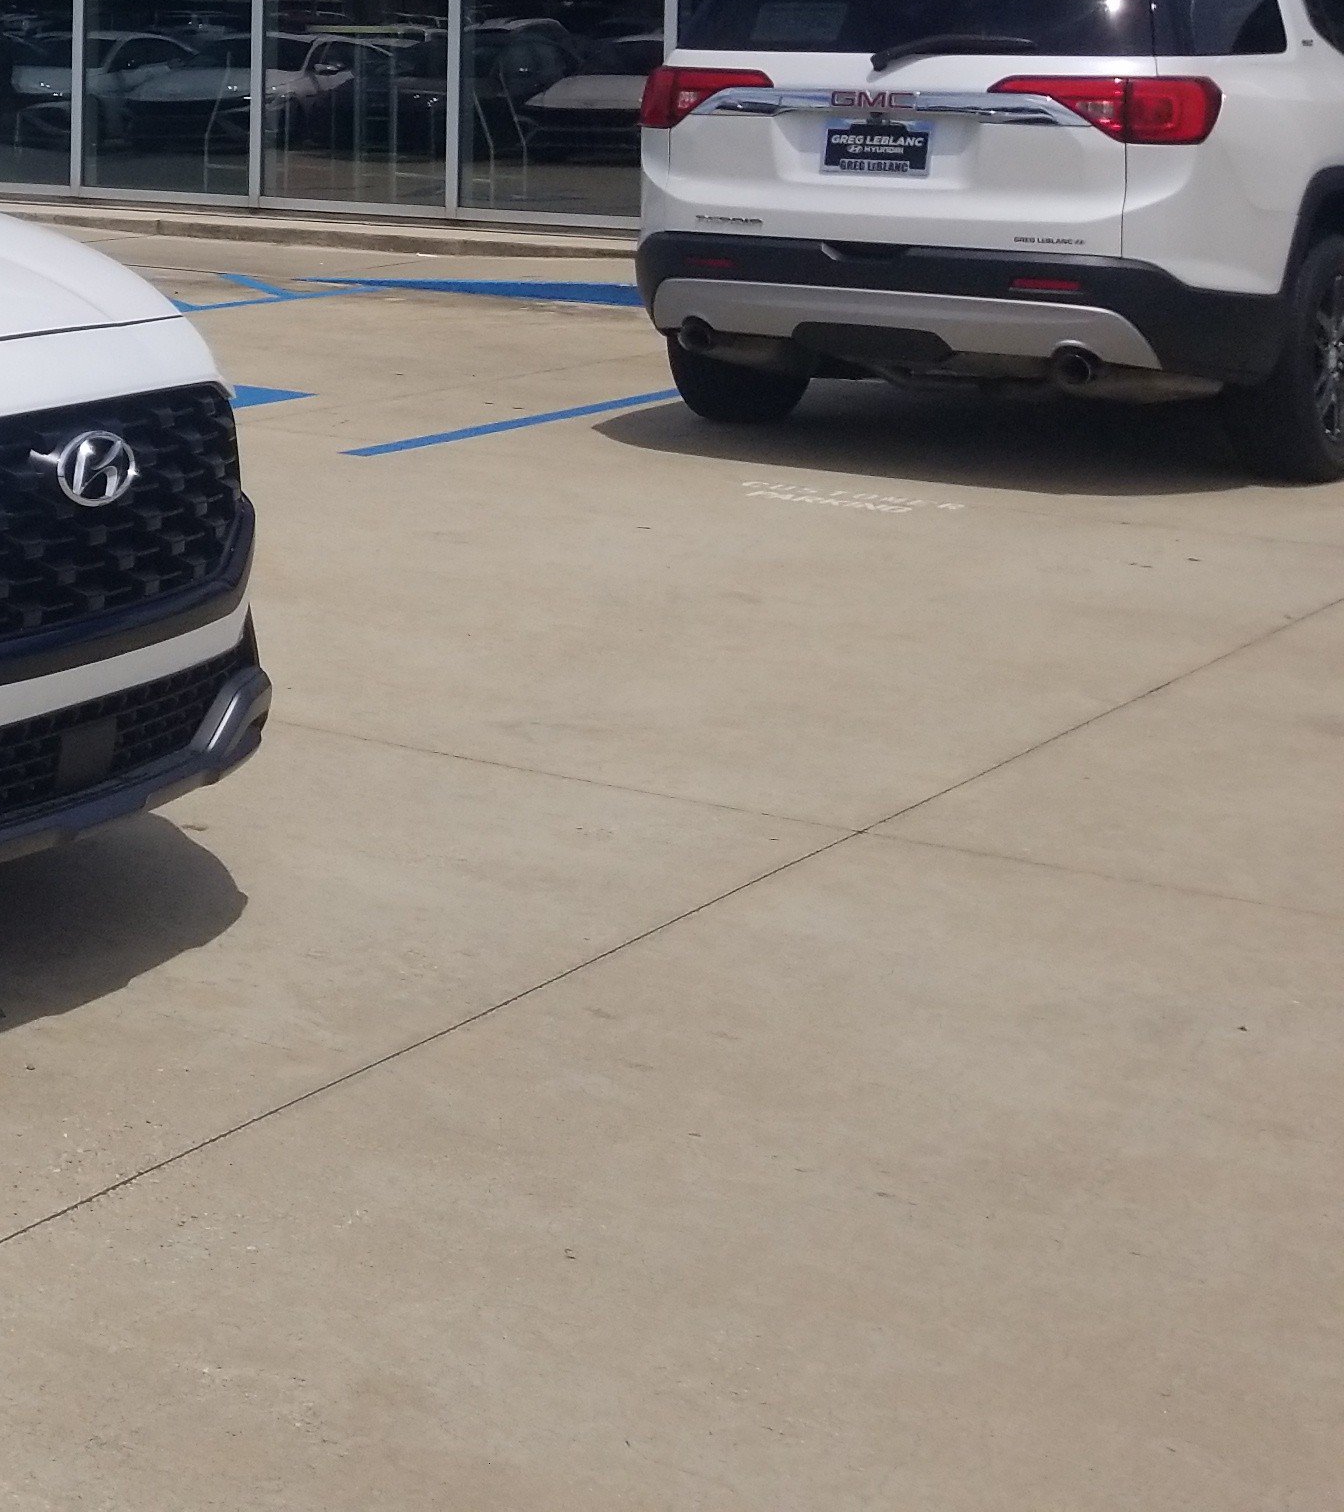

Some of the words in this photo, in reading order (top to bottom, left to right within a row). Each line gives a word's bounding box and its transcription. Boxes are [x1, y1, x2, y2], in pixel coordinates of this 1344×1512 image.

[832, 90, 914, 109] GMC
[832, 134, 863, 145] GREG
[866, 136, 924, 147] LEBLANC
[840, 159, 865, 170] GREG
[745, 491, 912, 513] PARKING
